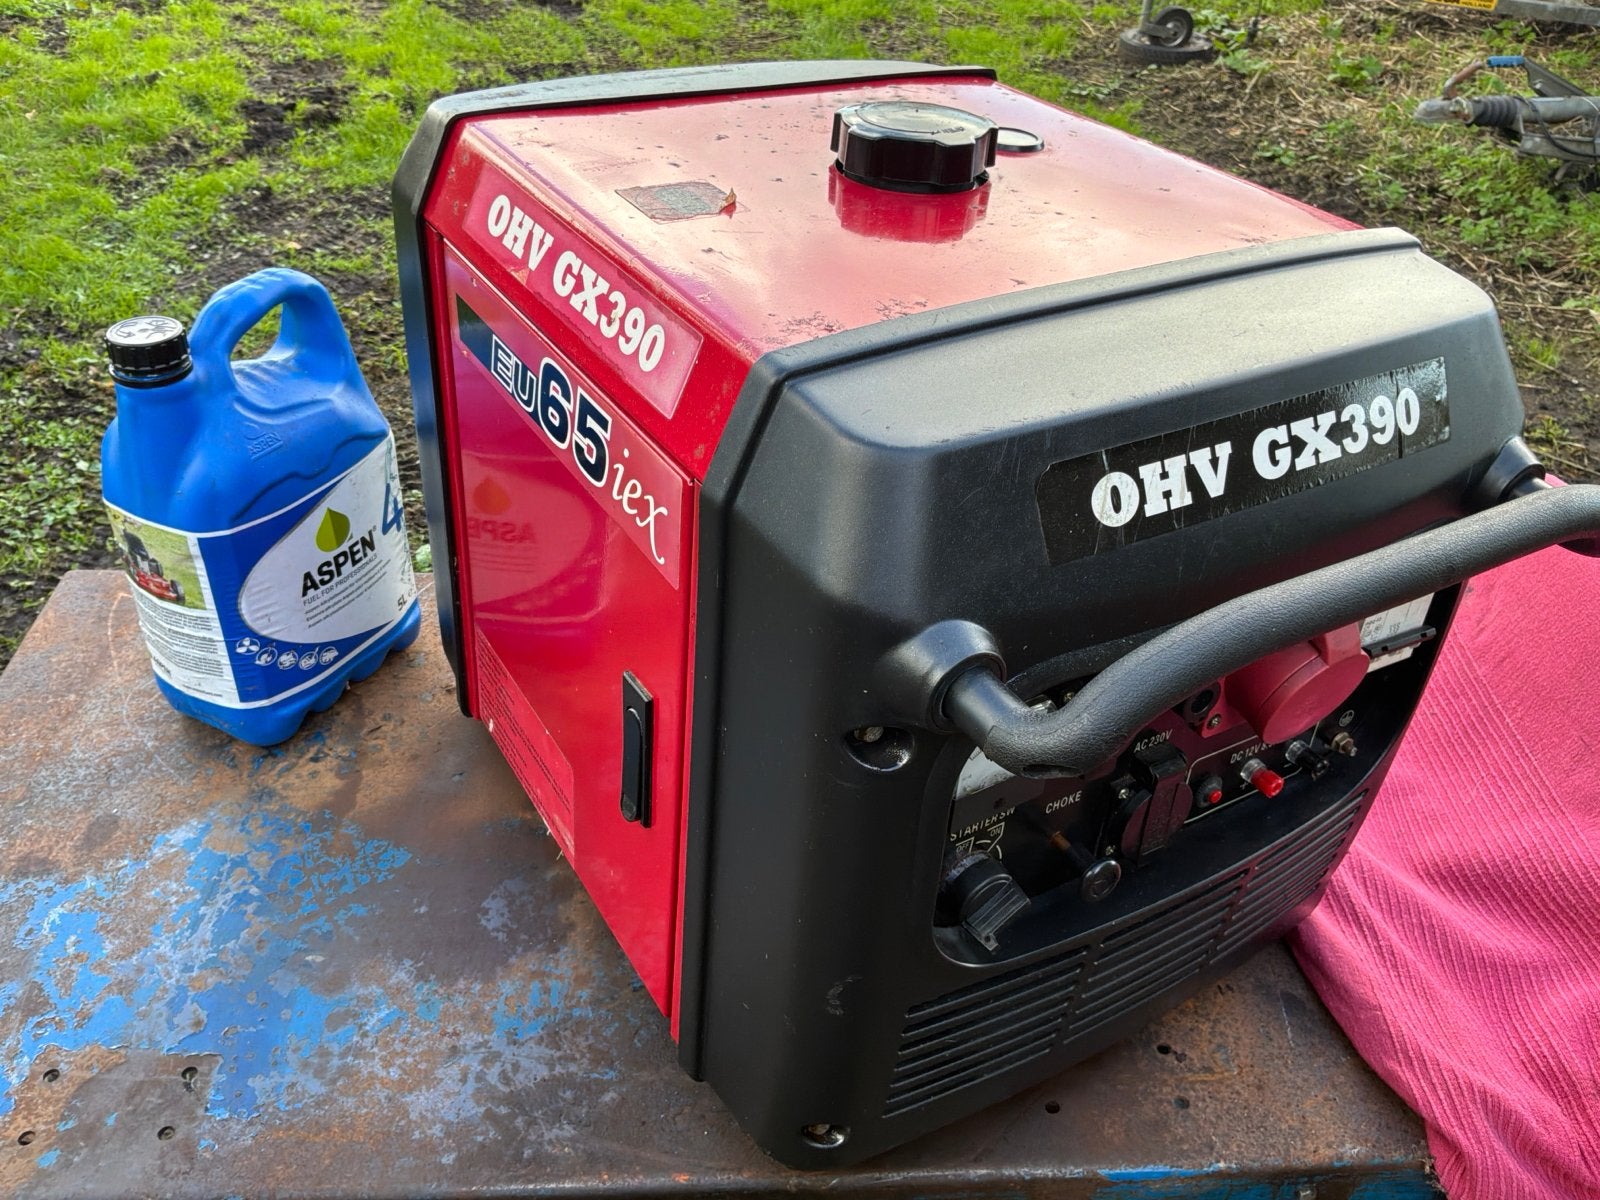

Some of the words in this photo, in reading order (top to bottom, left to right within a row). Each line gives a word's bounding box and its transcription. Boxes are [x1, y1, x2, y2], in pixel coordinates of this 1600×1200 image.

[488, 194, 554, 271] OHV
[553, 250, 665, 372] GX390
[1091, 441, 1232, 527] OHV
[1252, 388, 1420, 480] GX390
[301, 529, 376, 598] ASPEN
[303, 593, 321, 607] FUEL
[321, 584, 335, 597] FOR
[335, 552, 378, 588] PROFESSIONALS
[1133, 739, 1149, 753] AC
[1149, 729, 1173, 747] 230V
[1230, 750, 1244, 764] DC
[1245, 742, 1262, 758] 12V
[1045, 790, 1082, 814] CHOKE
[990, 826, 1001, 837] ON
[956, 841, 970, 852] OFF
